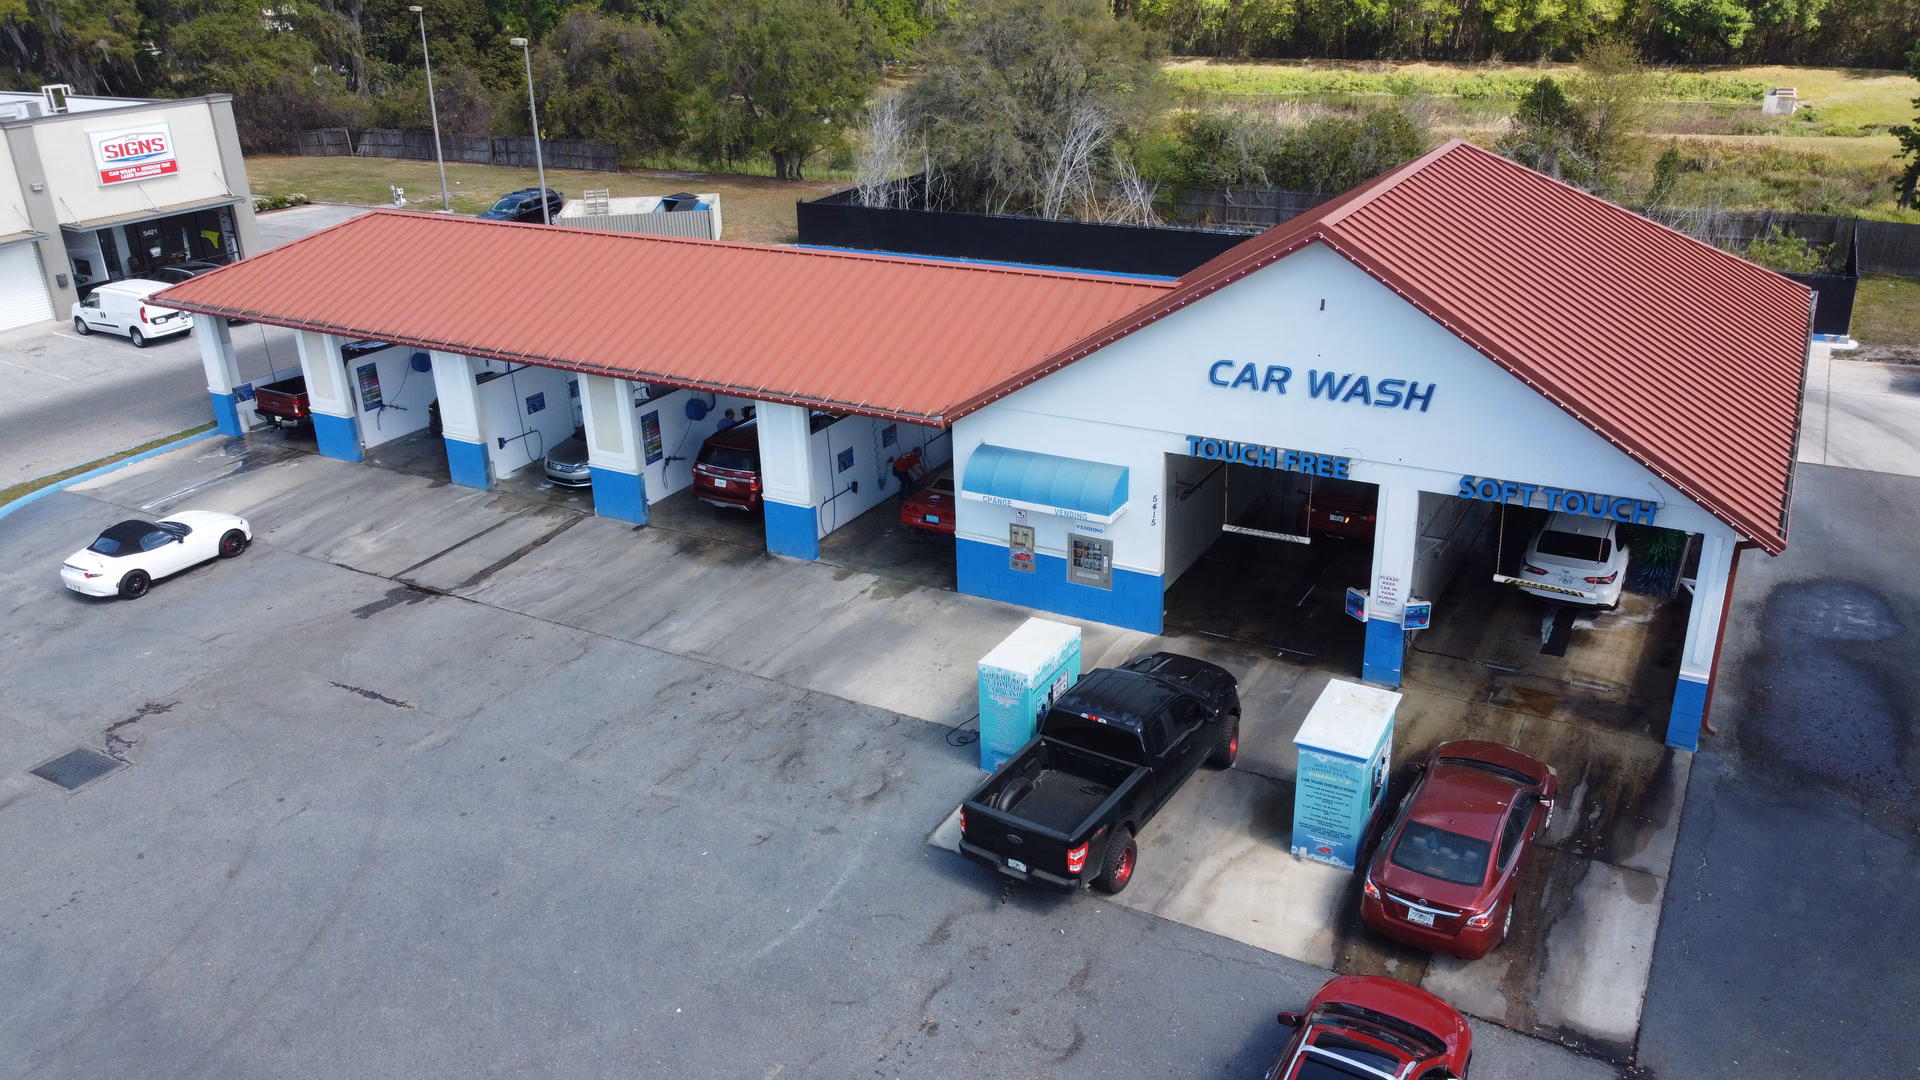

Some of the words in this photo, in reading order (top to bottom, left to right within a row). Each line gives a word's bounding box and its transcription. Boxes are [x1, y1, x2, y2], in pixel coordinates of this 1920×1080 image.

[104, 138, 165, 159] SIGNS
[1208, 359, 1293, 395] CAR
[1307, 369, 1436, 413] WASH
[1185, 434, 1279, 469] TOUCH
[1283, 450, 1351, 480] FREE
[982, 495, 1011, 506] CHANGE
[1458, 475, 1539, 508] SOFT
[1543, 487, 1658, 526] TOUCH
[1054, 508, 1087, 519] VENDING
[1076, 524, 1103, 533] VENDING
[982, 672, 1006, 681] TOUCH
[983, 678, 1024, 691] AUTOMATIC
[986, 685, 1000, 694] CAR
[1001, 688, 1021, 697] WASH
[1302, 766, 1332, 774] AUTOMATIC
[1344, 774, 1359, 783] WASH
[1329, 765, 1347, 774] TOUCH
[1323, 782, 1357, 794] INSTRUCTIONS
